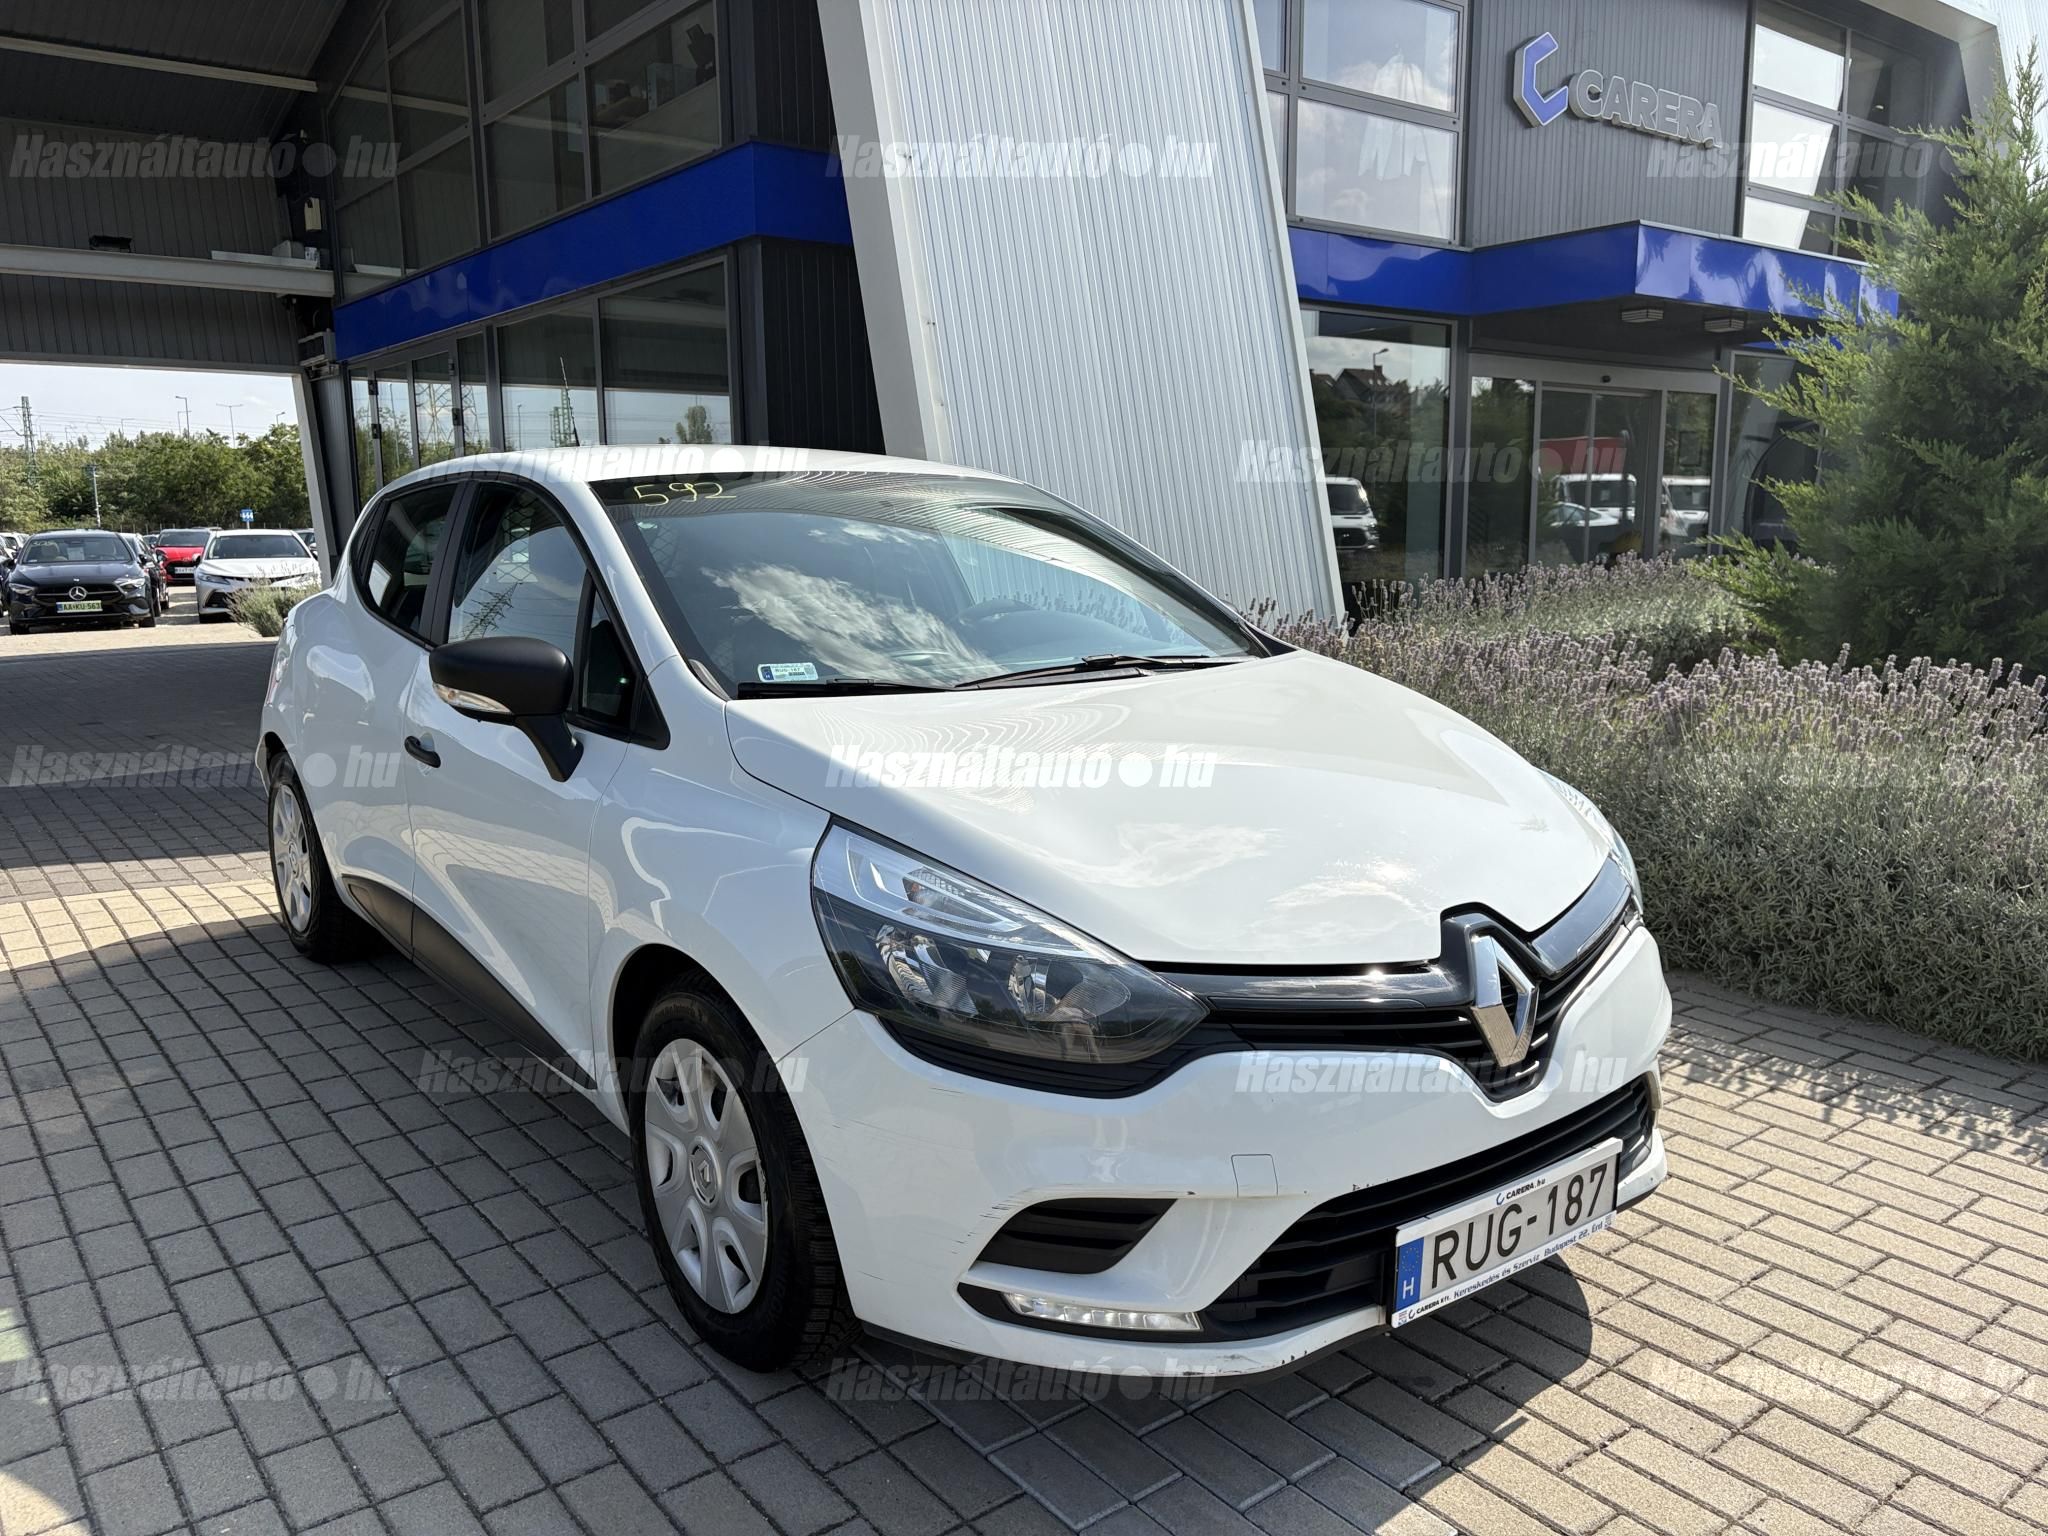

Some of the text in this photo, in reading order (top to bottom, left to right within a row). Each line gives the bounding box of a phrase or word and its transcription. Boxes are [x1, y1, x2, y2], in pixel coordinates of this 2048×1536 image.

[1571, 69, 1723, 148] CARERA
[633, 482, 737, 506] 592
[1431, 1163, 1608, 1289] RUG-187
[1402, 1277, 1415, 1299] H
[1416, 1301, 1440, 1314] CARERA
[1544, 1236, 1576, 1257] Budapest
